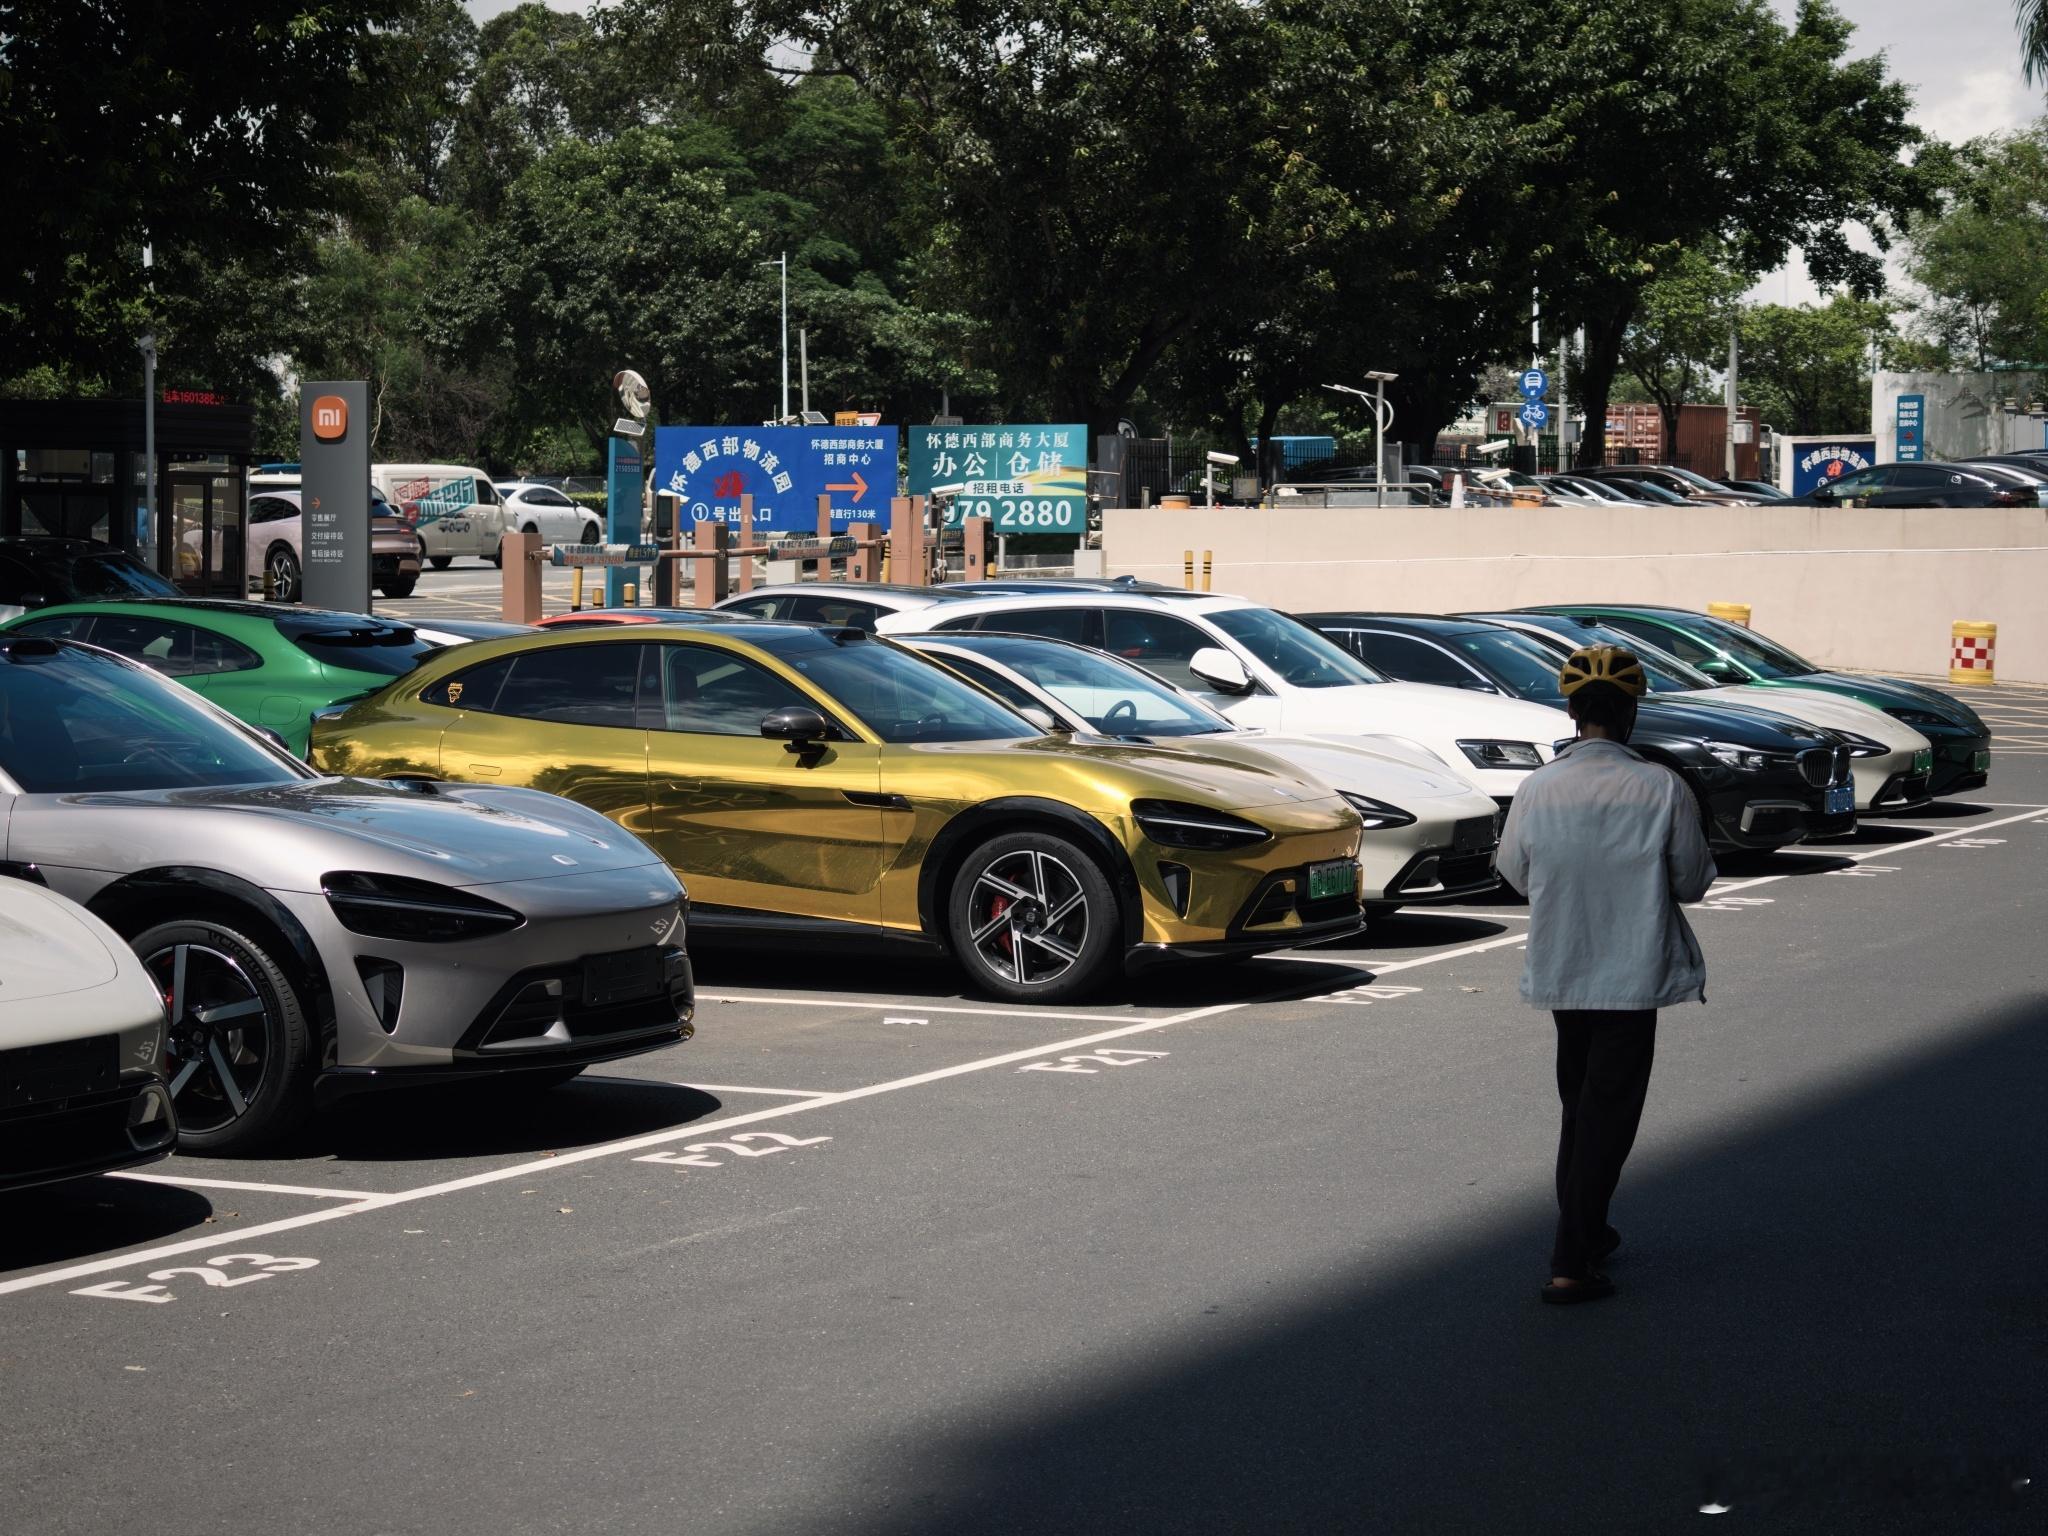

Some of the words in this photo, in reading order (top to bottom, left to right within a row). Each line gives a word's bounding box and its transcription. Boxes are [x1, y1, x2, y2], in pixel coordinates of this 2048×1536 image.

[811, 439, 884, 450] 怀德西部商务大厦
[926, 432, 1069, 449] 怀德西部商务大厦
[669, 436, 792, 494] 怀德西部物流园
[824, 453, 871, 465] 招商中心
[931, 451, 988, 477] 办公
[1006, 451, 1064, 477] 仓储
[973, 483, 1025, 494] 招租电话
[1000, 500, 1072, 526] 2880
[1300, 985, 1424, 1004] F20
[1017, 1048, 1171, 1074] F21
[631, 1132, 833, 1167] F22
[68, 1253, 320, 1303] F23
